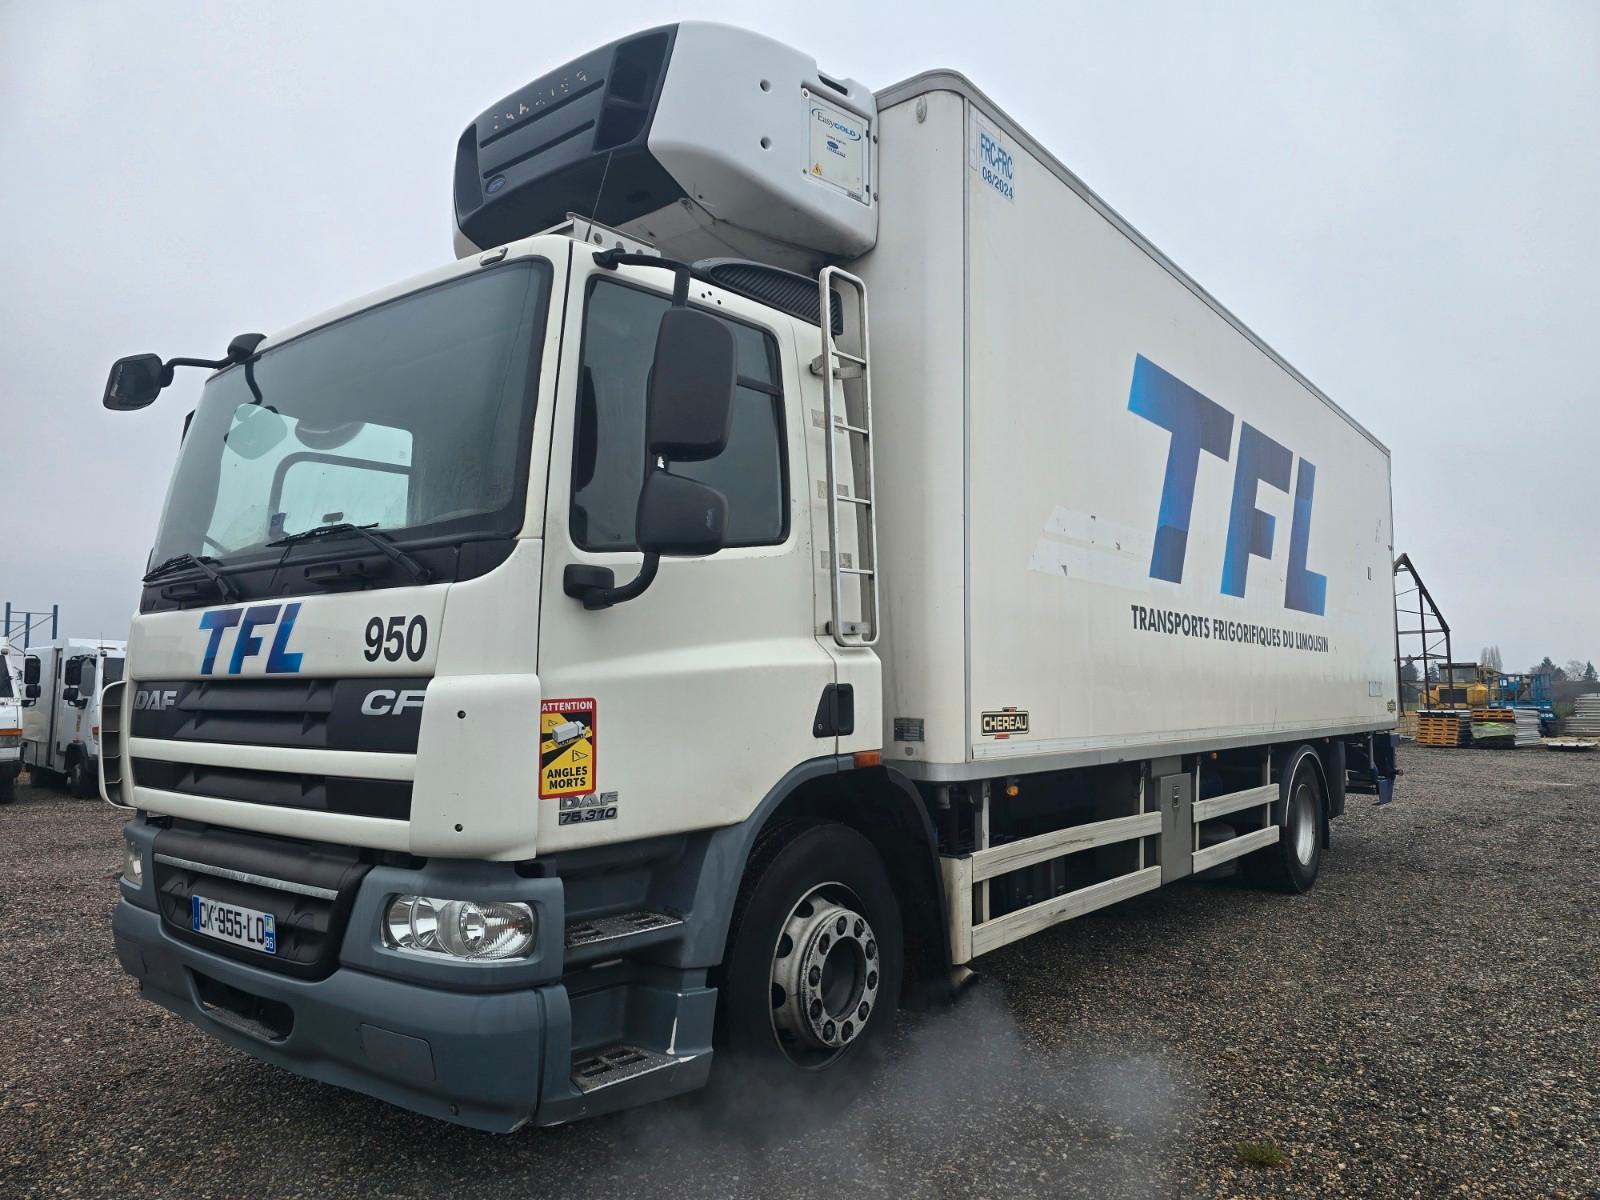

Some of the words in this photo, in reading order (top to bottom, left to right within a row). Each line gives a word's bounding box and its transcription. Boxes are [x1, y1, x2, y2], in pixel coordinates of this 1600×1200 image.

[817, 111, 856, 137] EasyCOLD
[980, 133, 1013, 180] FRC-FRC
[982, 166, 1013, 200] 08/2024
[1127, 352, 1328, 617] TFL
[198, 602, 304, 675] TFL
[363, 614, 428, 662] 950
[1130, 604, 1210, 639] TRANSPORTS
[1212, 618, 1281, 648] FRIGORIFIQUES
[1282, 629, 1295, 649] DU
[1295, 630, 1330, 653] LIMOUSIN
[134, 690, 178, 711] DAF
[360, 689, 425, 716] CF
[541, 701, 593, 712] ATTENTION
[983, 715, 1027, 731] CHEREAU
[546, 766, 588, 779] ANGLES
[549, 776, 586, 790] MORTS
[559, 791, 618, 811] DAF
[560, 807, 617, 824] 75.310
